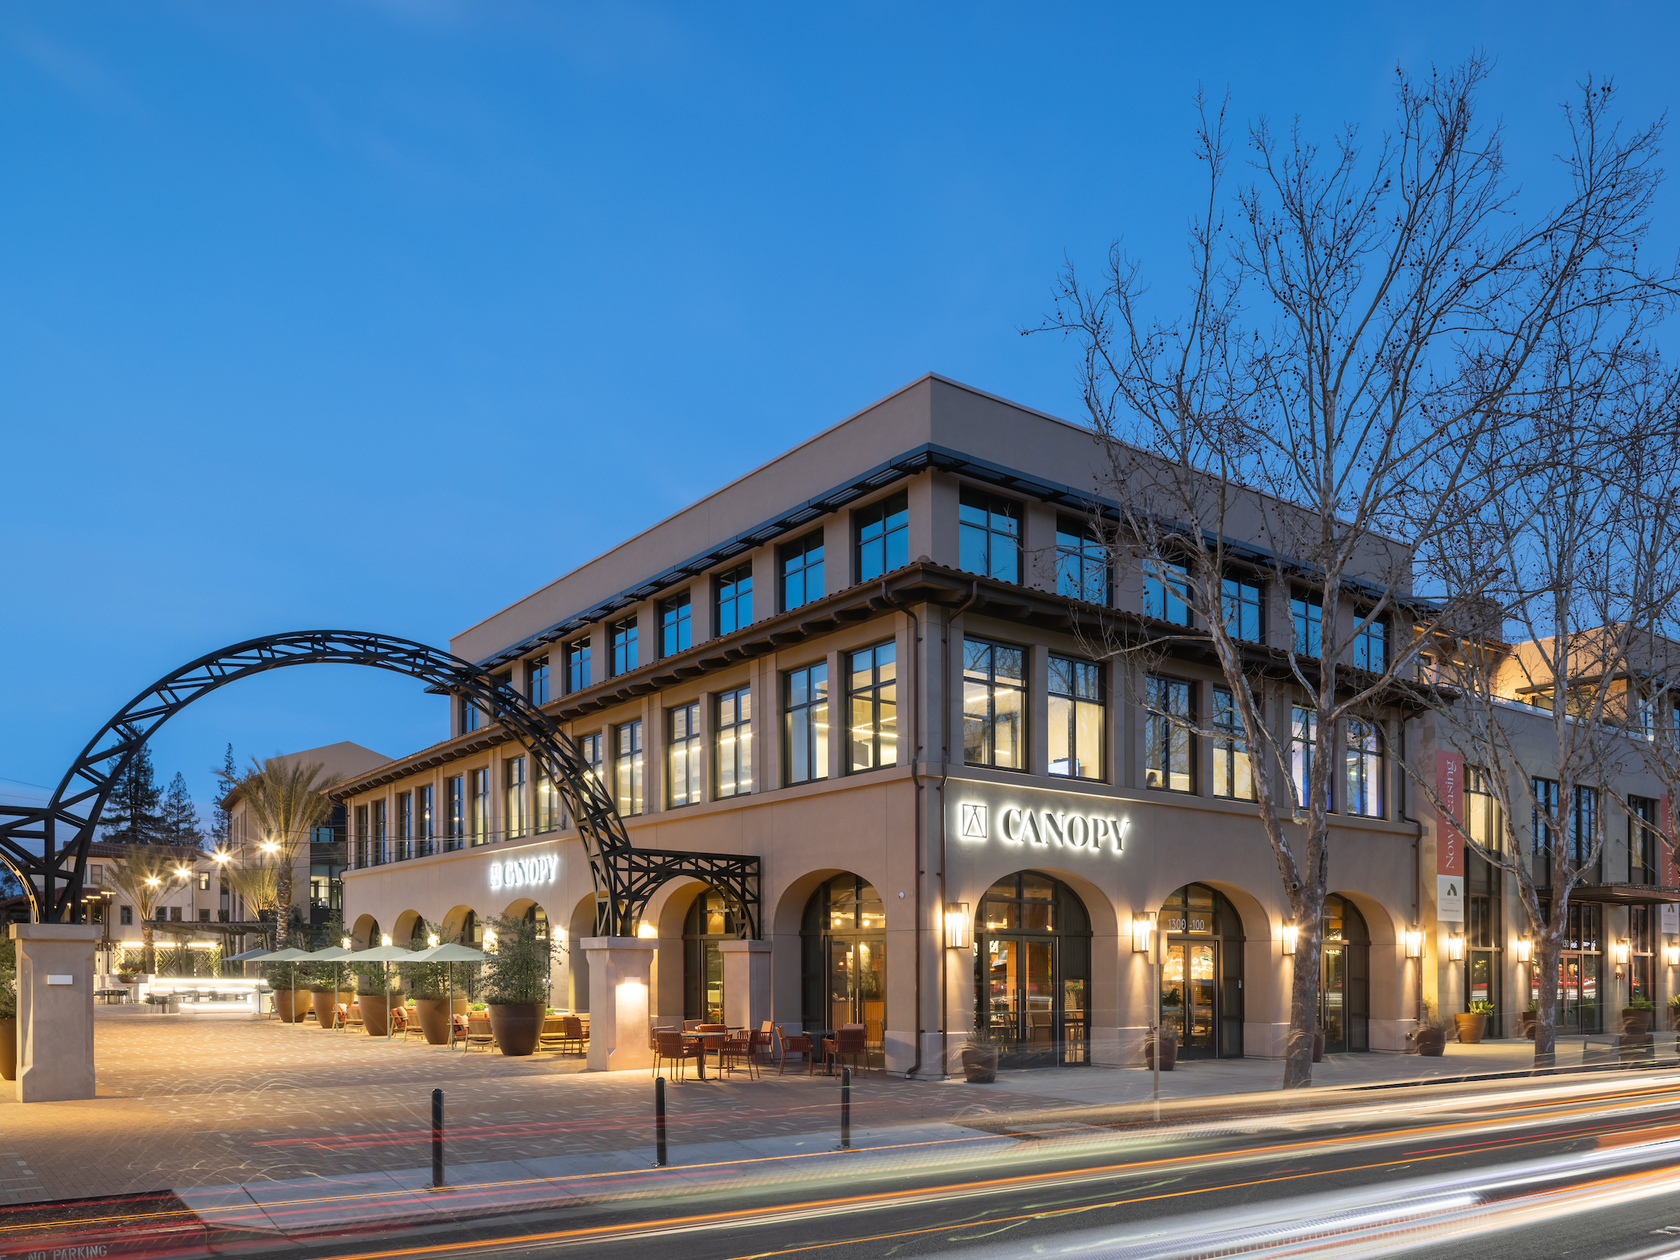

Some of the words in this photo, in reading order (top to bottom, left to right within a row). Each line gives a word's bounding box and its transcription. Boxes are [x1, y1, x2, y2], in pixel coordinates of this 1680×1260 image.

[1002, 808, 1130, 851] CANOPY
[1446, 830, 1454, 869] Now
[503, 856, 557, 885] CANOPY
[28, 1251, 46, 1260] NO
[53, 1245, 107, 1260] PARKING
